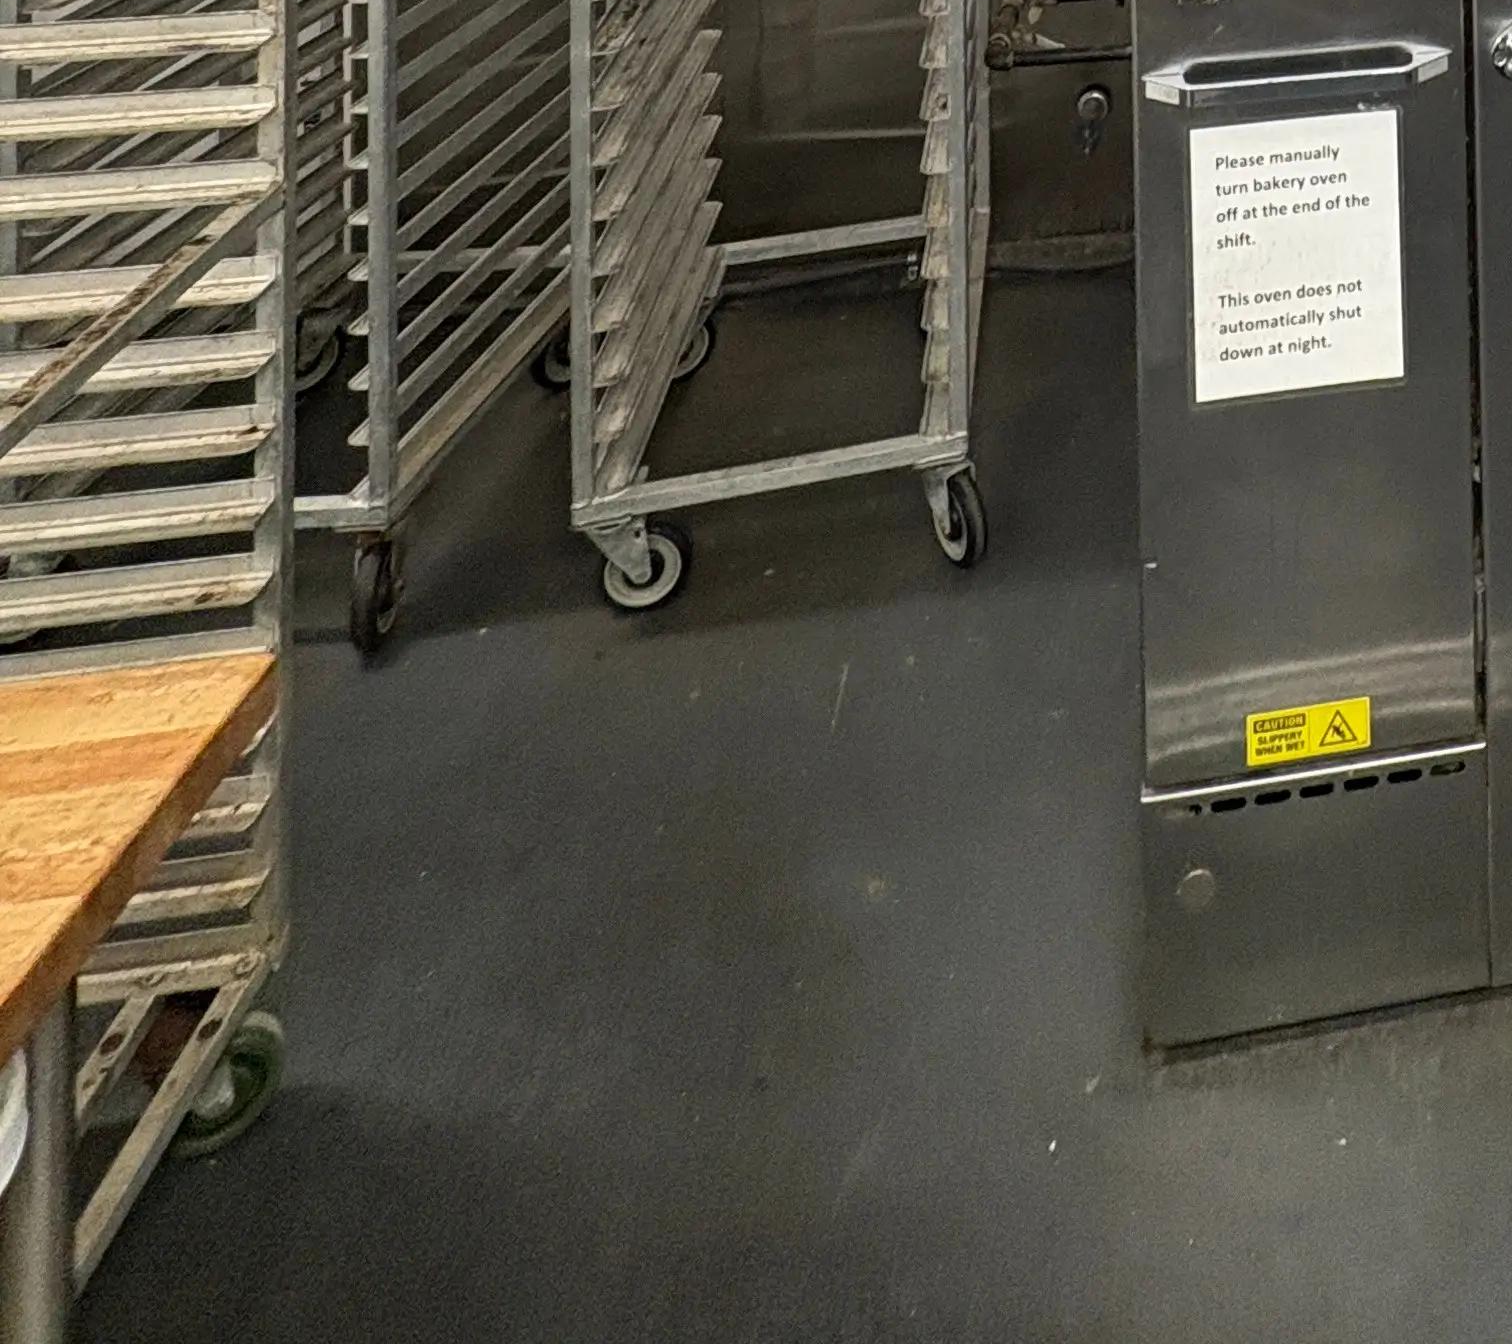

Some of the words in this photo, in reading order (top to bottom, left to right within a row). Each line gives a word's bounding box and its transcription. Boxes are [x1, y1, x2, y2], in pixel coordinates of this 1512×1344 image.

[1215, 153, 1265, 170] Please
[1270, 145, 1340, 163] manually
[1216, 182, 1249, 197] turn
[1253, 175, 1306, 193] bakery
[1310, 171, 1348, 187] oven
[1216, 206, 1238, 223] off
[1242, 207, 1258, 220] at
[1262, 202, 1288, 218] the
[1292, 197, 1321, 214] end
[1325, 195, 1341, 210] of
[1345, 194, 1370, 209] the
[1216, 232, 1257, 250] shift.
[1218, 291, 1250, 309] This
[1254, 288, 1292, 304] oven
[1296, 283, 1333, 299] does
[1337, 279, 1363, 294] not
[1218, 308, 1325, 335] automatically
[1329, 305, 1362, 321] shut
[1219, 344, 1264, 362] down
[1268, 343, 1284, 356] at
[1288, 335, 1333, 354] night.
[1256, 715, 1304, 732] CAUTION
[1255, 745, 1282, 757] WHEN
[1286, 741, 1305, 752] WET
[1257, 730, 1303, 745] SLIPPERY
